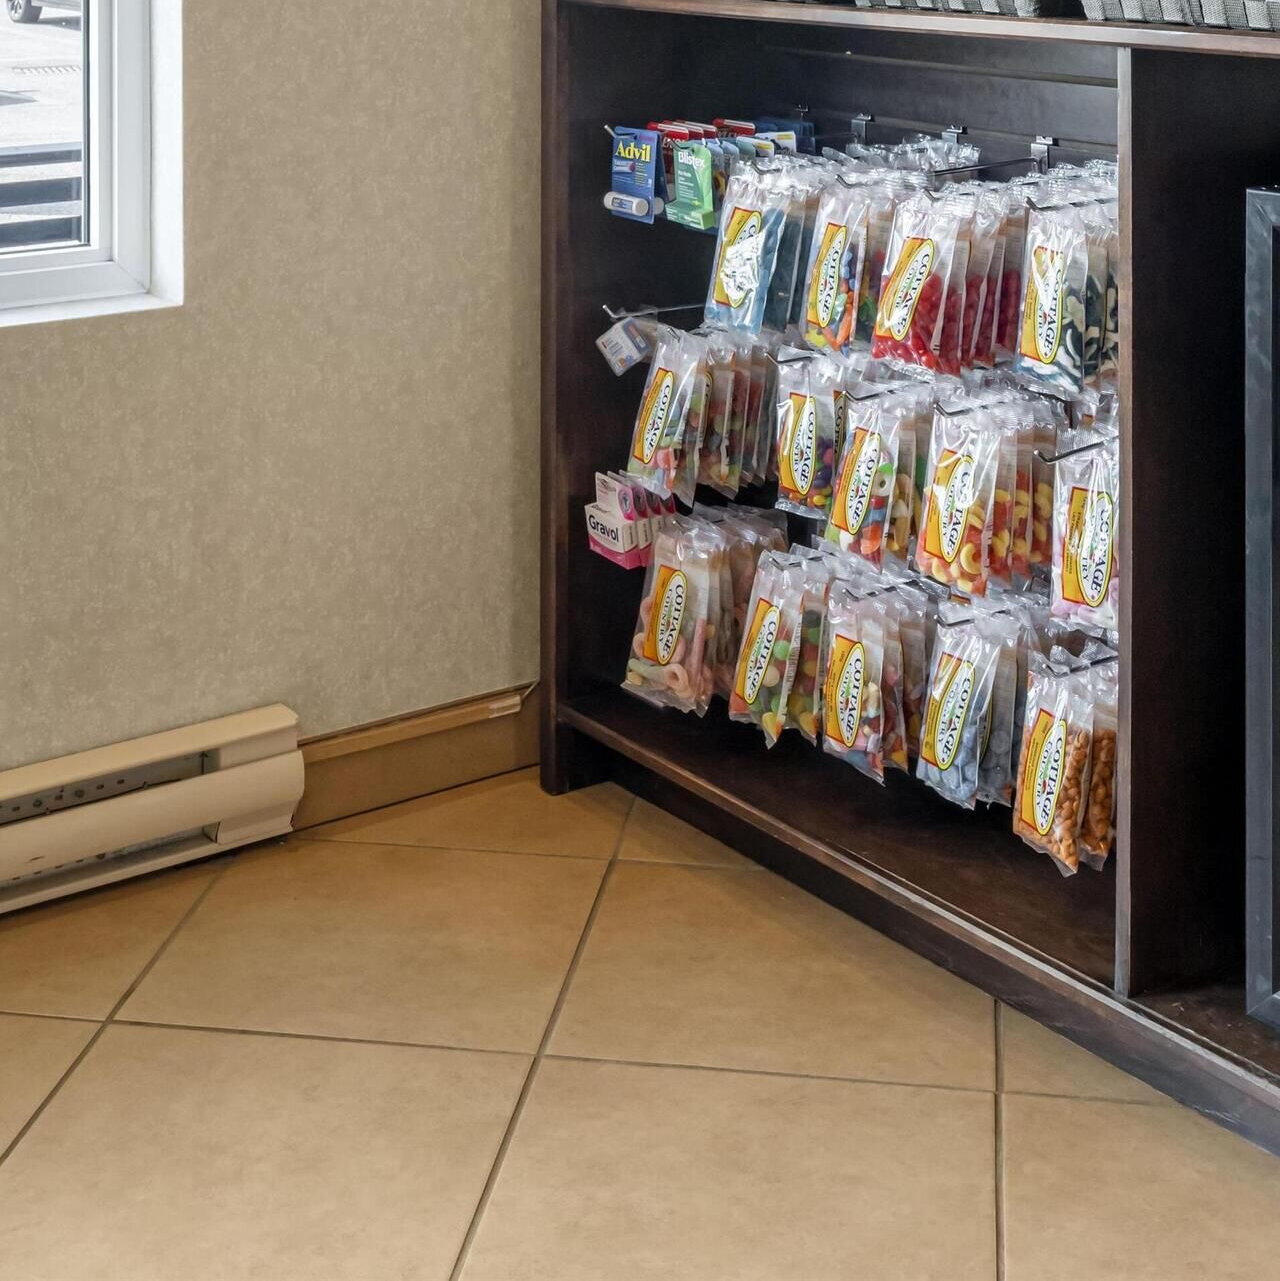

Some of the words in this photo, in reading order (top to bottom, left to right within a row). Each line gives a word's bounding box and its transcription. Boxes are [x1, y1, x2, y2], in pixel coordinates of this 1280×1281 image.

[615, 142, 651, 162] Advil
[678, 150, 705, 169] Blistex
[649, 385, 670, 455] COTTAGE
[800, 411, 815, 485] COTTAGE
[853, 447, 878, 524] COTTAGE
[588, 514, 619, 542] Gravol
[662, 584, 684, 658] COTTAGE
[749, 621, 776, 695] COTTAGE
[839, 661, 853, 723] COUNTRY
[846, 658, 862, 738] COTTAGE
[943, 677, 971, 756] COTTAGE
[1040, 738, 1062, 822] COTTAGE
